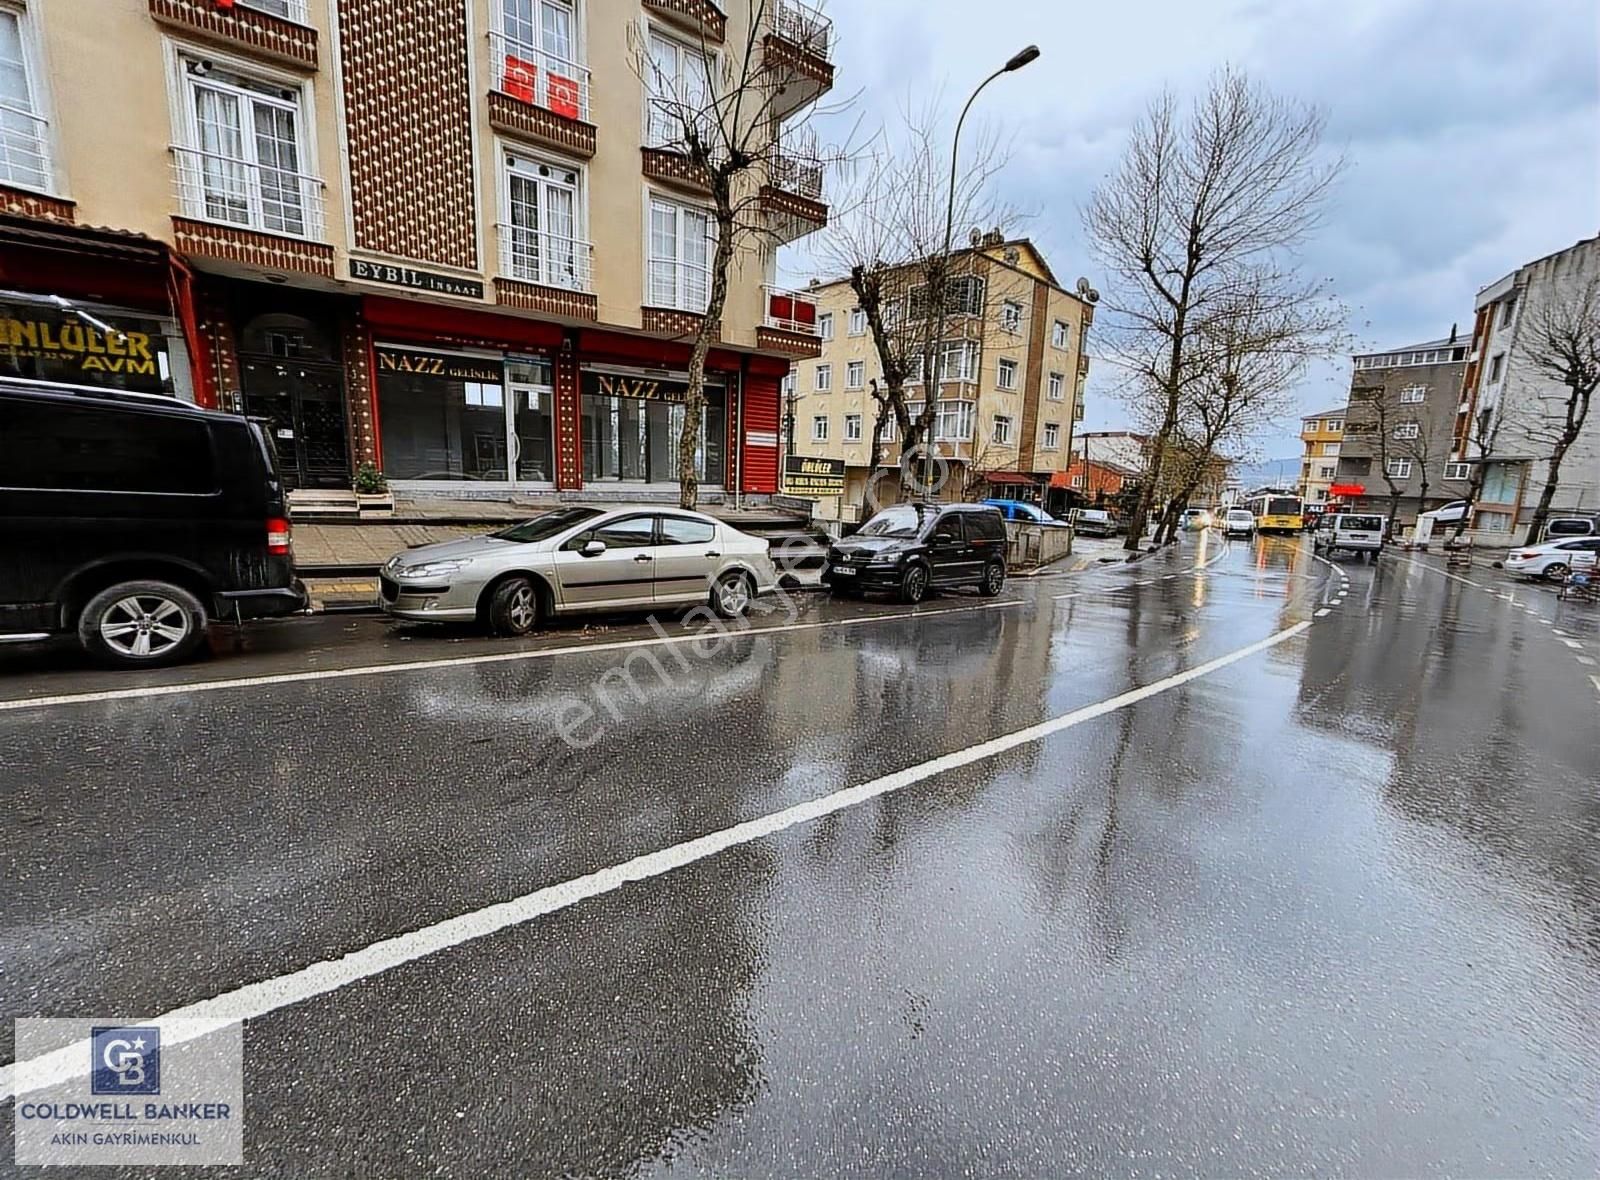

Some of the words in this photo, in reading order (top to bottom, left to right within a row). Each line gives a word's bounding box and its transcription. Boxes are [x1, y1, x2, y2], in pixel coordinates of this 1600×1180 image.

[355, 261, 422, 286] EYBİL
[81, 356, 155, 375] AVM
[379, 352, 444, 375] NAZZ
[598, 376, 660, 399] NAZZ
